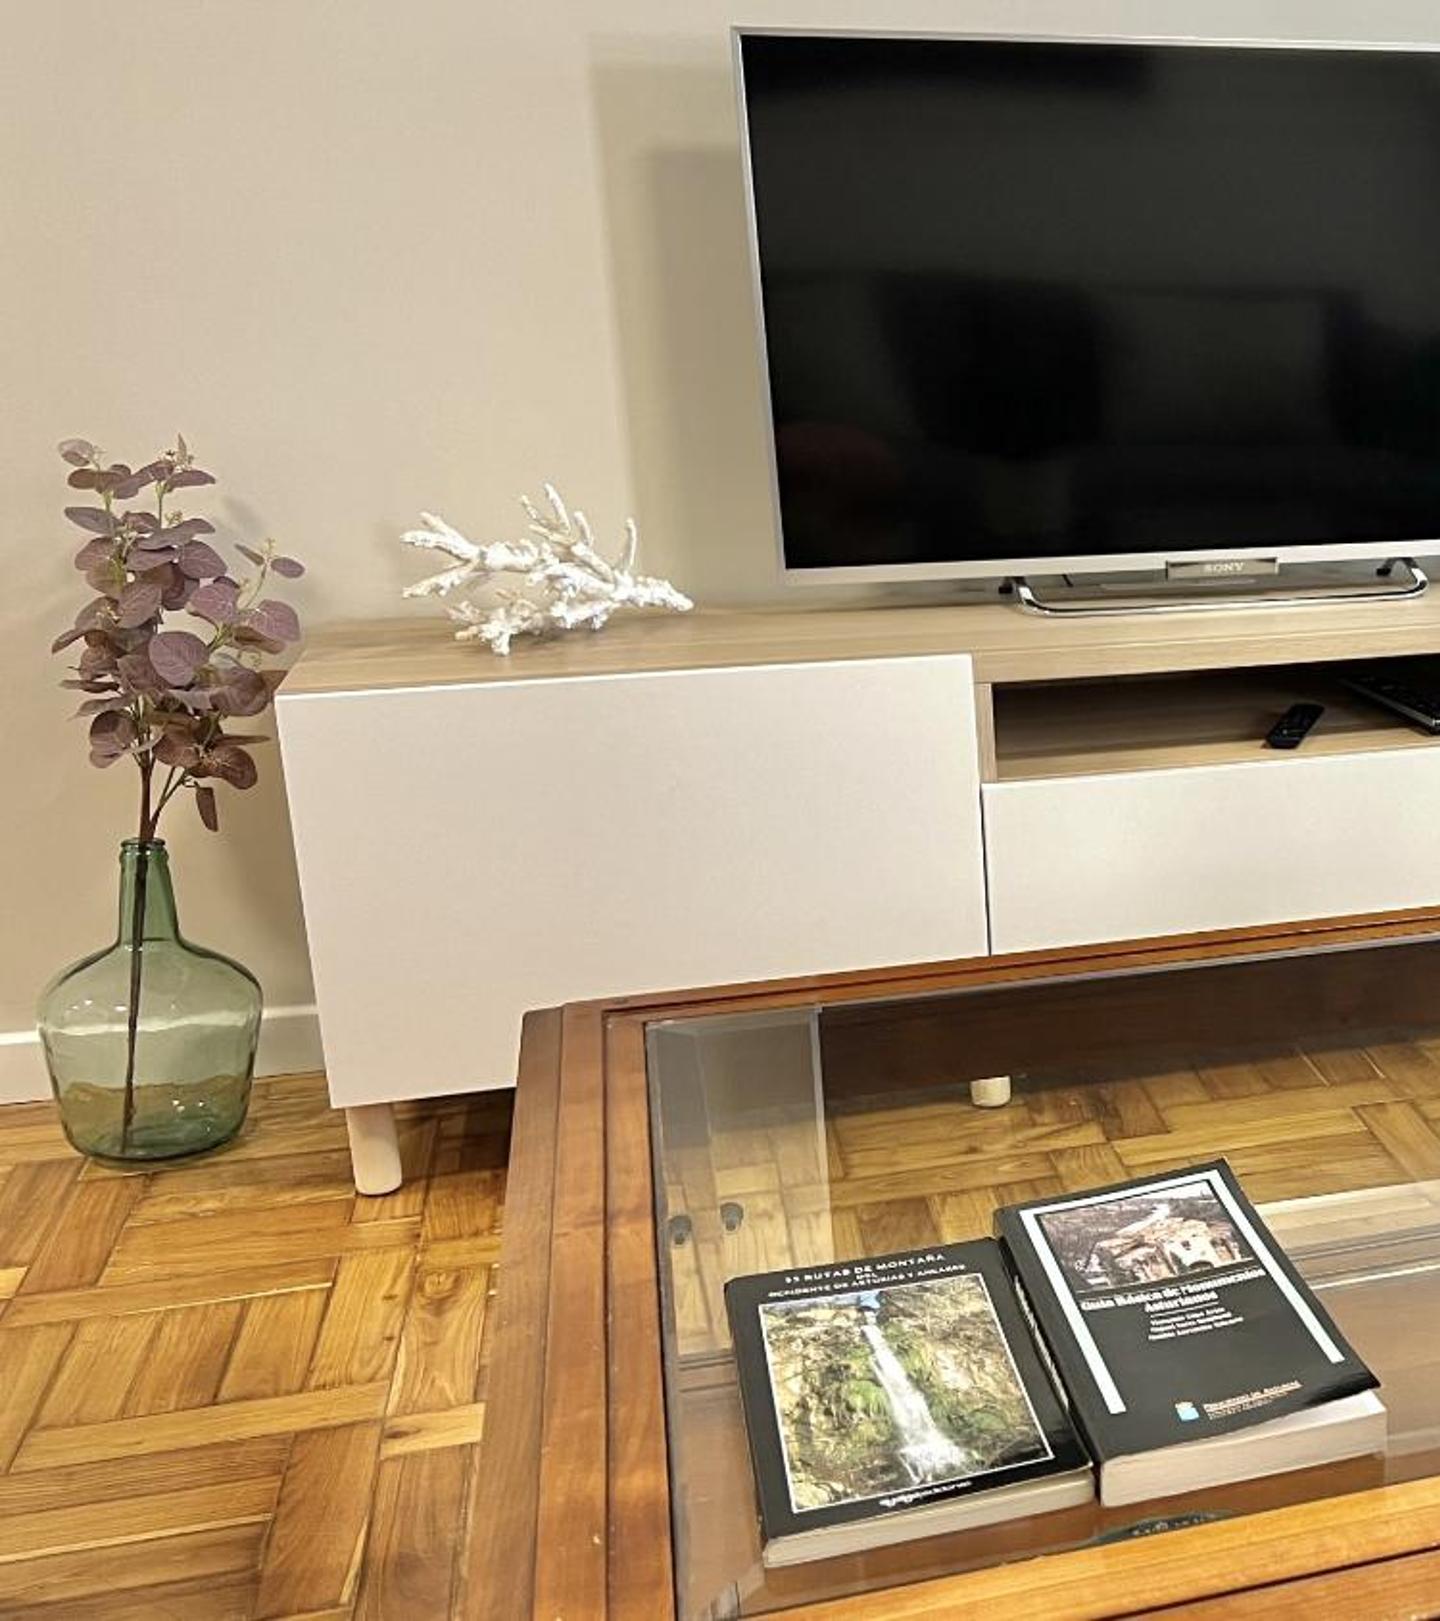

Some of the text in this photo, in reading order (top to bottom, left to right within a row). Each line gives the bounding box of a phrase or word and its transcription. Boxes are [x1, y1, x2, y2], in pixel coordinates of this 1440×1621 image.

[1203, 562, 1245, 573] SONY
[804, 1268, 850, 1281] RUTAS
[854, 1265, 872, 1274] DE
[876, 1253, 946, 1270] MONTAÑA
[851, 1274, 905, 1287] ASTURIAS
[1144, 1291, 1219, 1312] Asturianos
